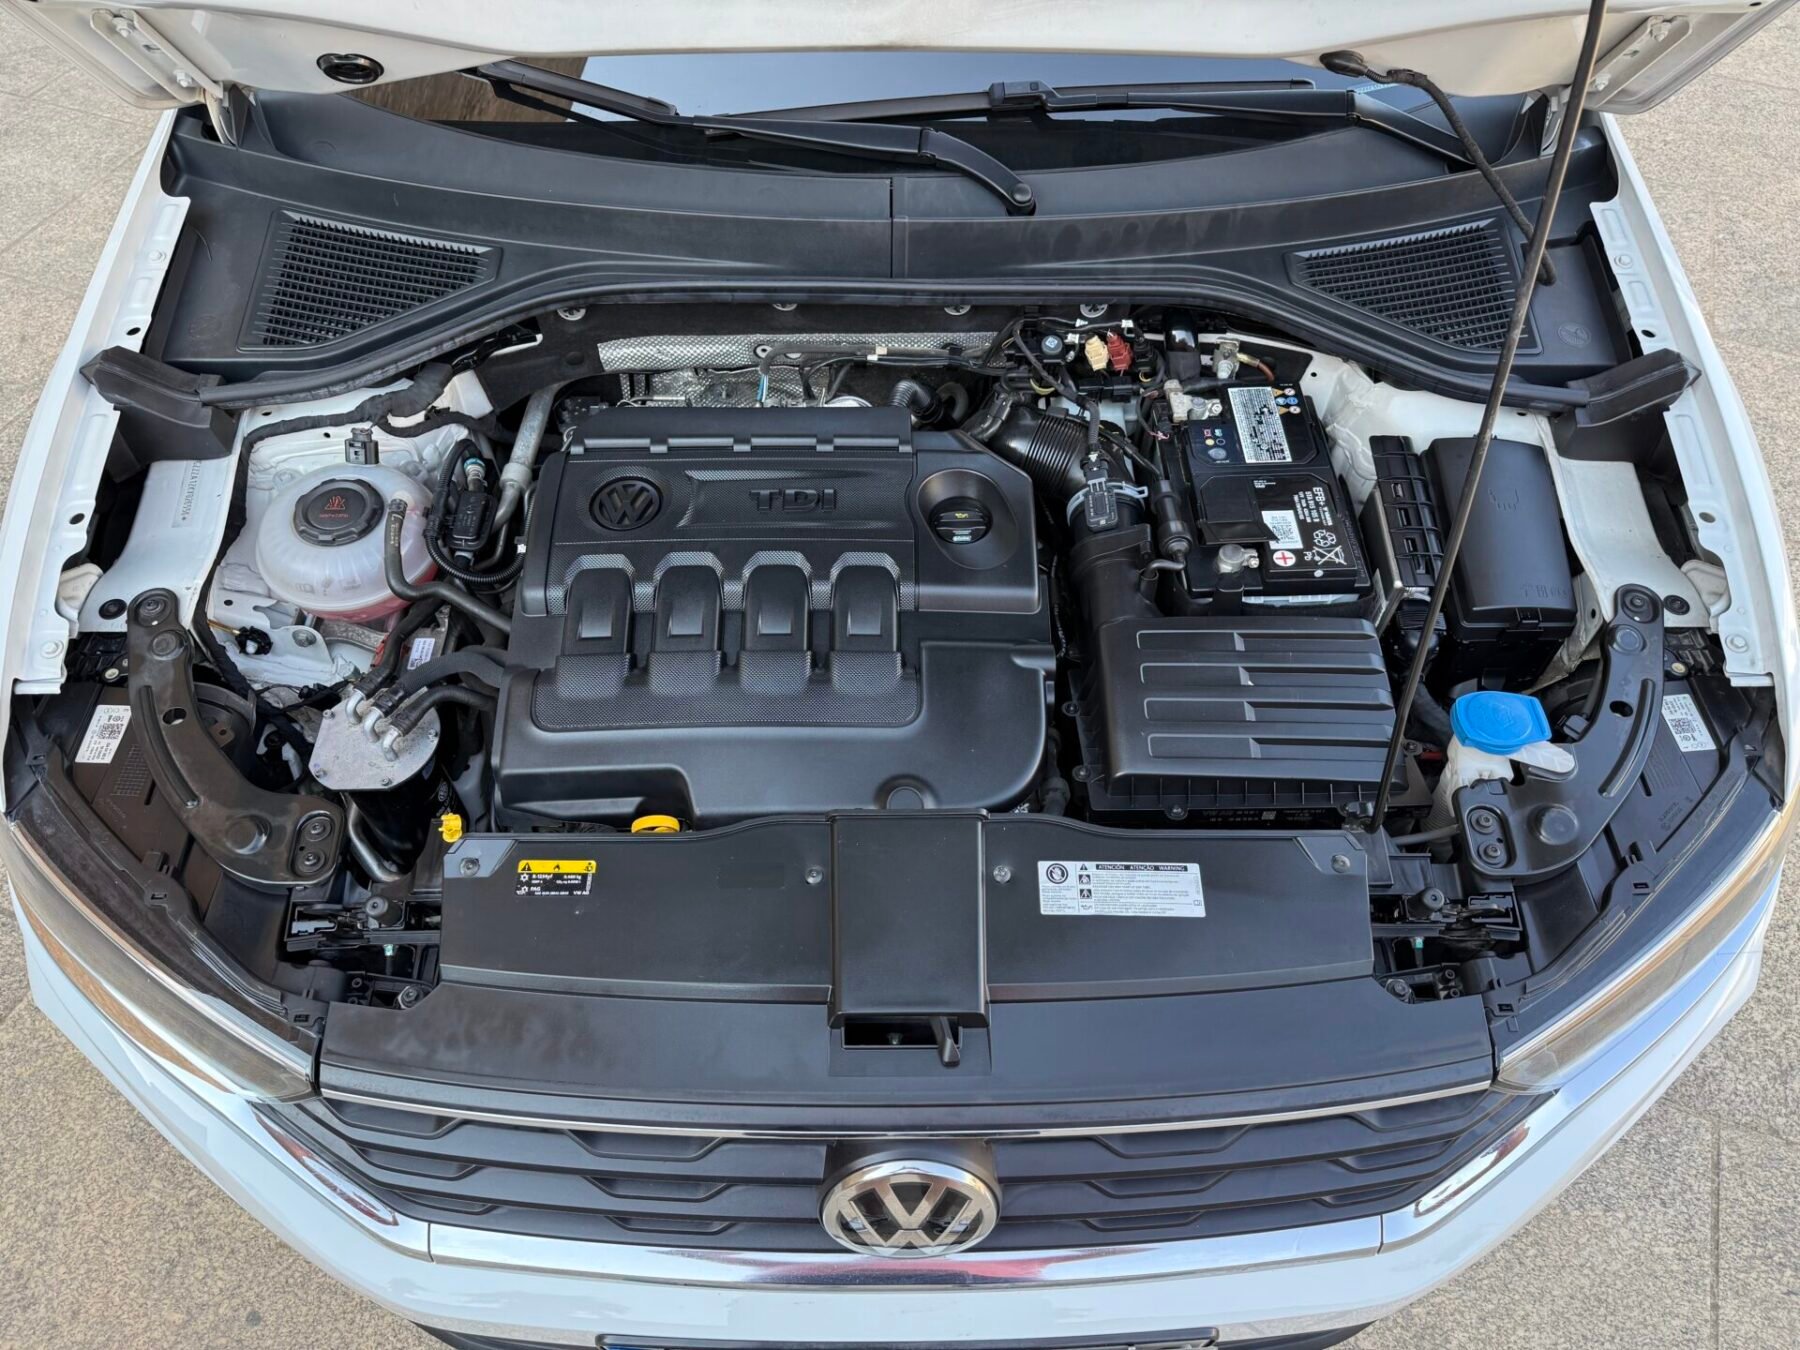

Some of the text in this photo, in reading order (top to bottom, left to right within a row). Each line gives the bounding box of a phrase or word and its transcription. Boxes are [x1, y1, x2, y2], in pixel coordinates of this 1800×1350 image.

[751, 488, 837, 512] TDI
[1129, 863, 1155, 871] ATENÇÃO
[1158, 864, 1185, 872] WARNING
[830, 1168, 990, 1258] VW
